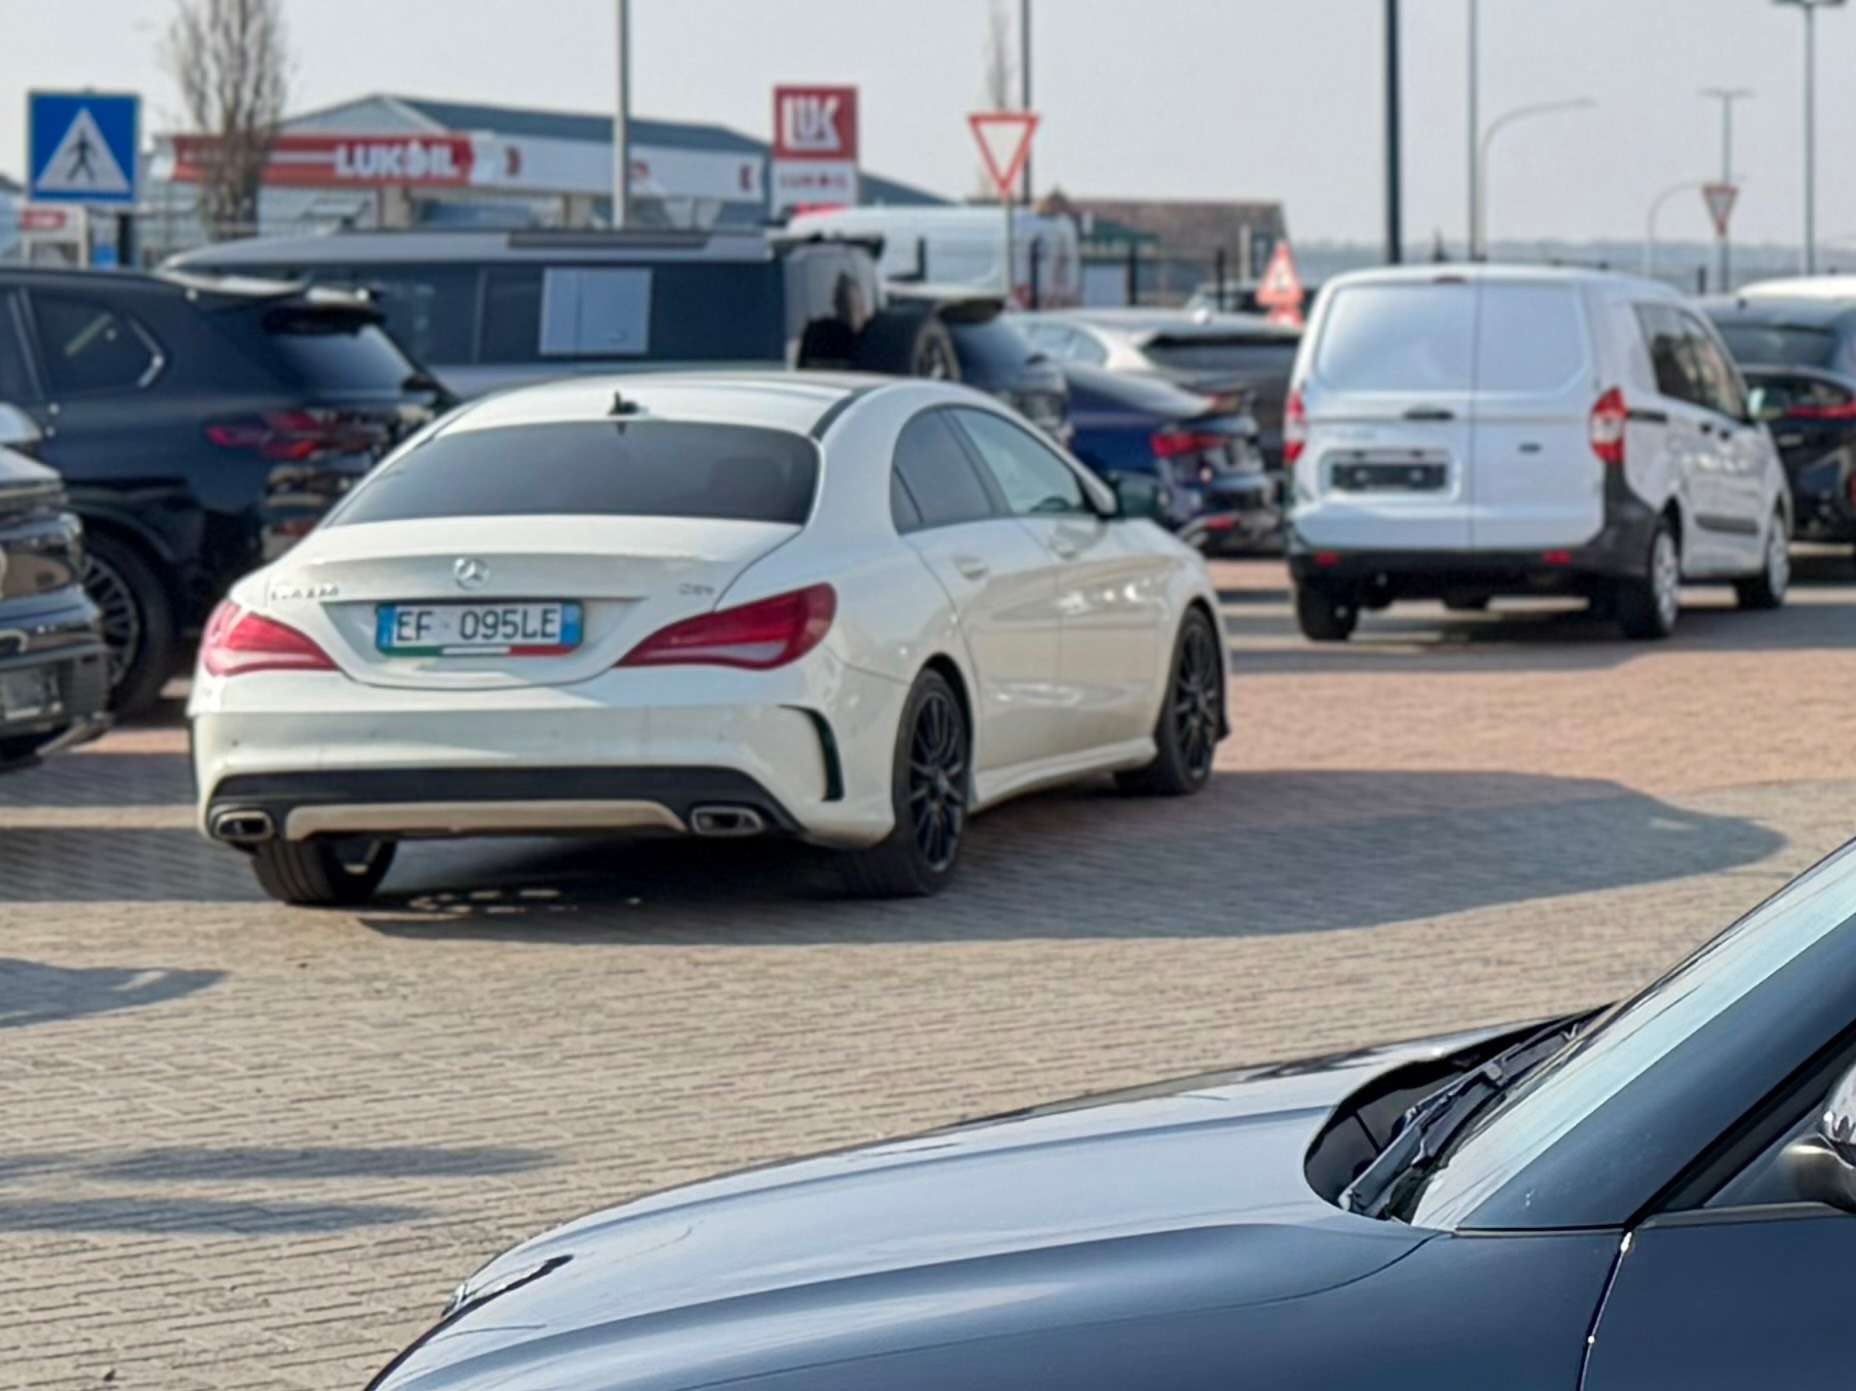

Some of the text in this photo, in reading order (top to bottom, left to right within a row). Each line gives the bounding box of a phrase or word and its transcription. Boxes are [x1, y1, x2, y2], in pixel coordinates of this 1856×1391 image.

[335, 139, 461, 179] LUKOIL
[396, 608, 559, 642] EF 095LE
